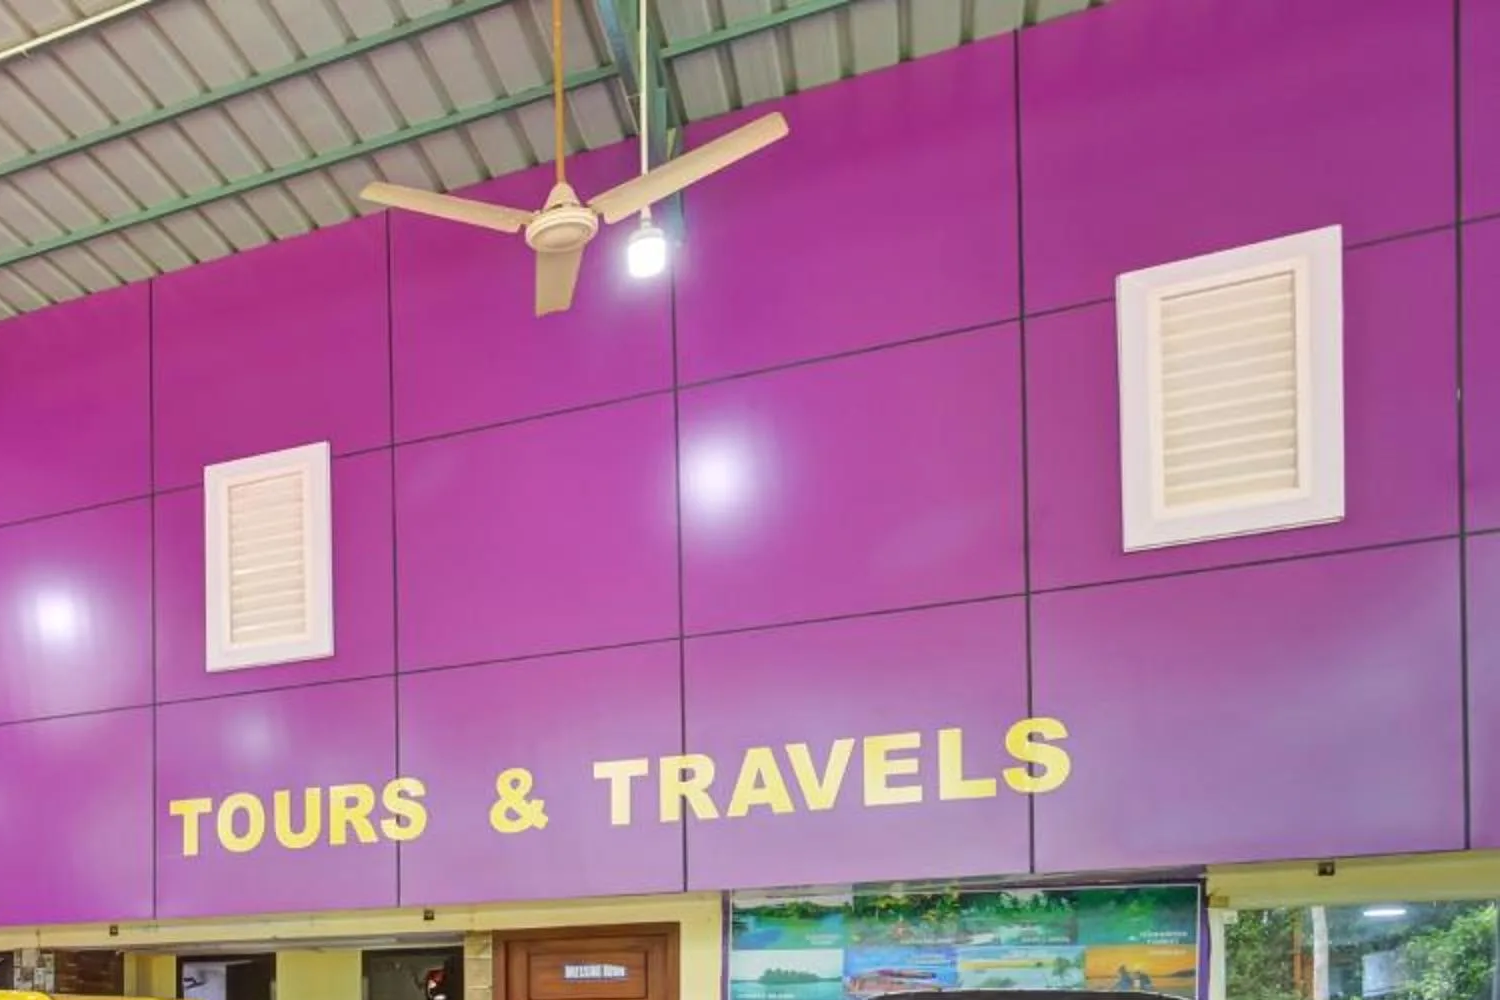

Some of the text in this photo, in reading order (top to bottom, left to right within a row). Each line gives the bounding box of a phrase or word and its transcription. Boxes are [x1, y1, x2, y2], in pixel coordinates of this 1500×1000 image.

[169, 717, 1073, 857] TOURS & TRAVELS
